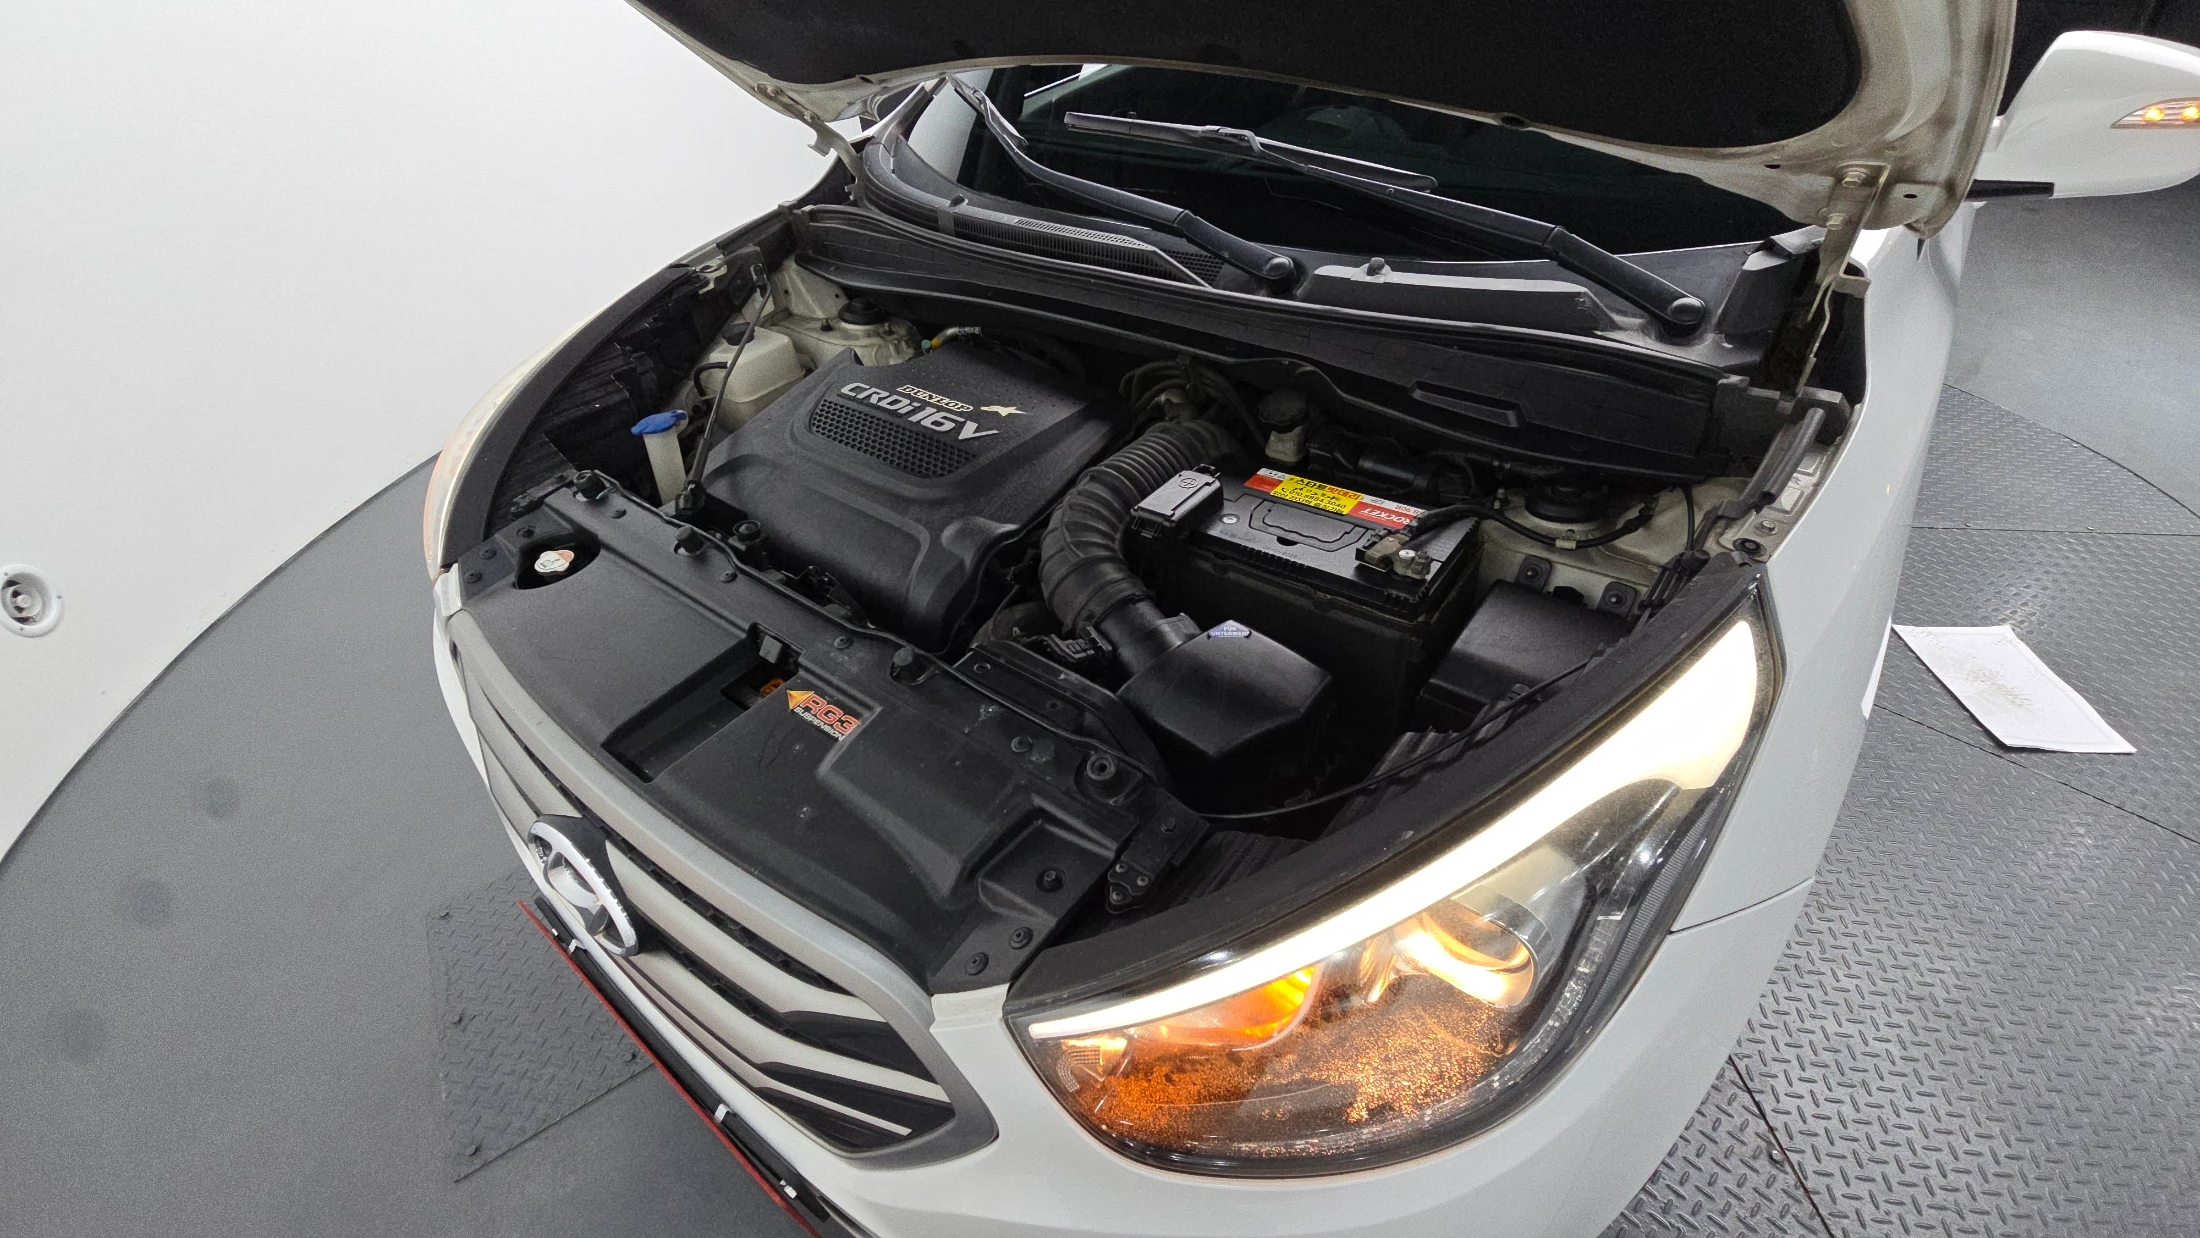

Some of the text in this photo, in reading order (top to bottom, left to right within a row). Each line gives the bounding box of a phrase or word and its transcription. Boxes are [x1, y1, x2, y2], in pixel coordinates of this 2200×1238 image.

[896, 384, 974, 412] DUNLOP
[1359, 507, 1411, 525] ROCKET
[794, 706, 845, 741] SUSPENSION
[799, 694, 860, 736] RG3
